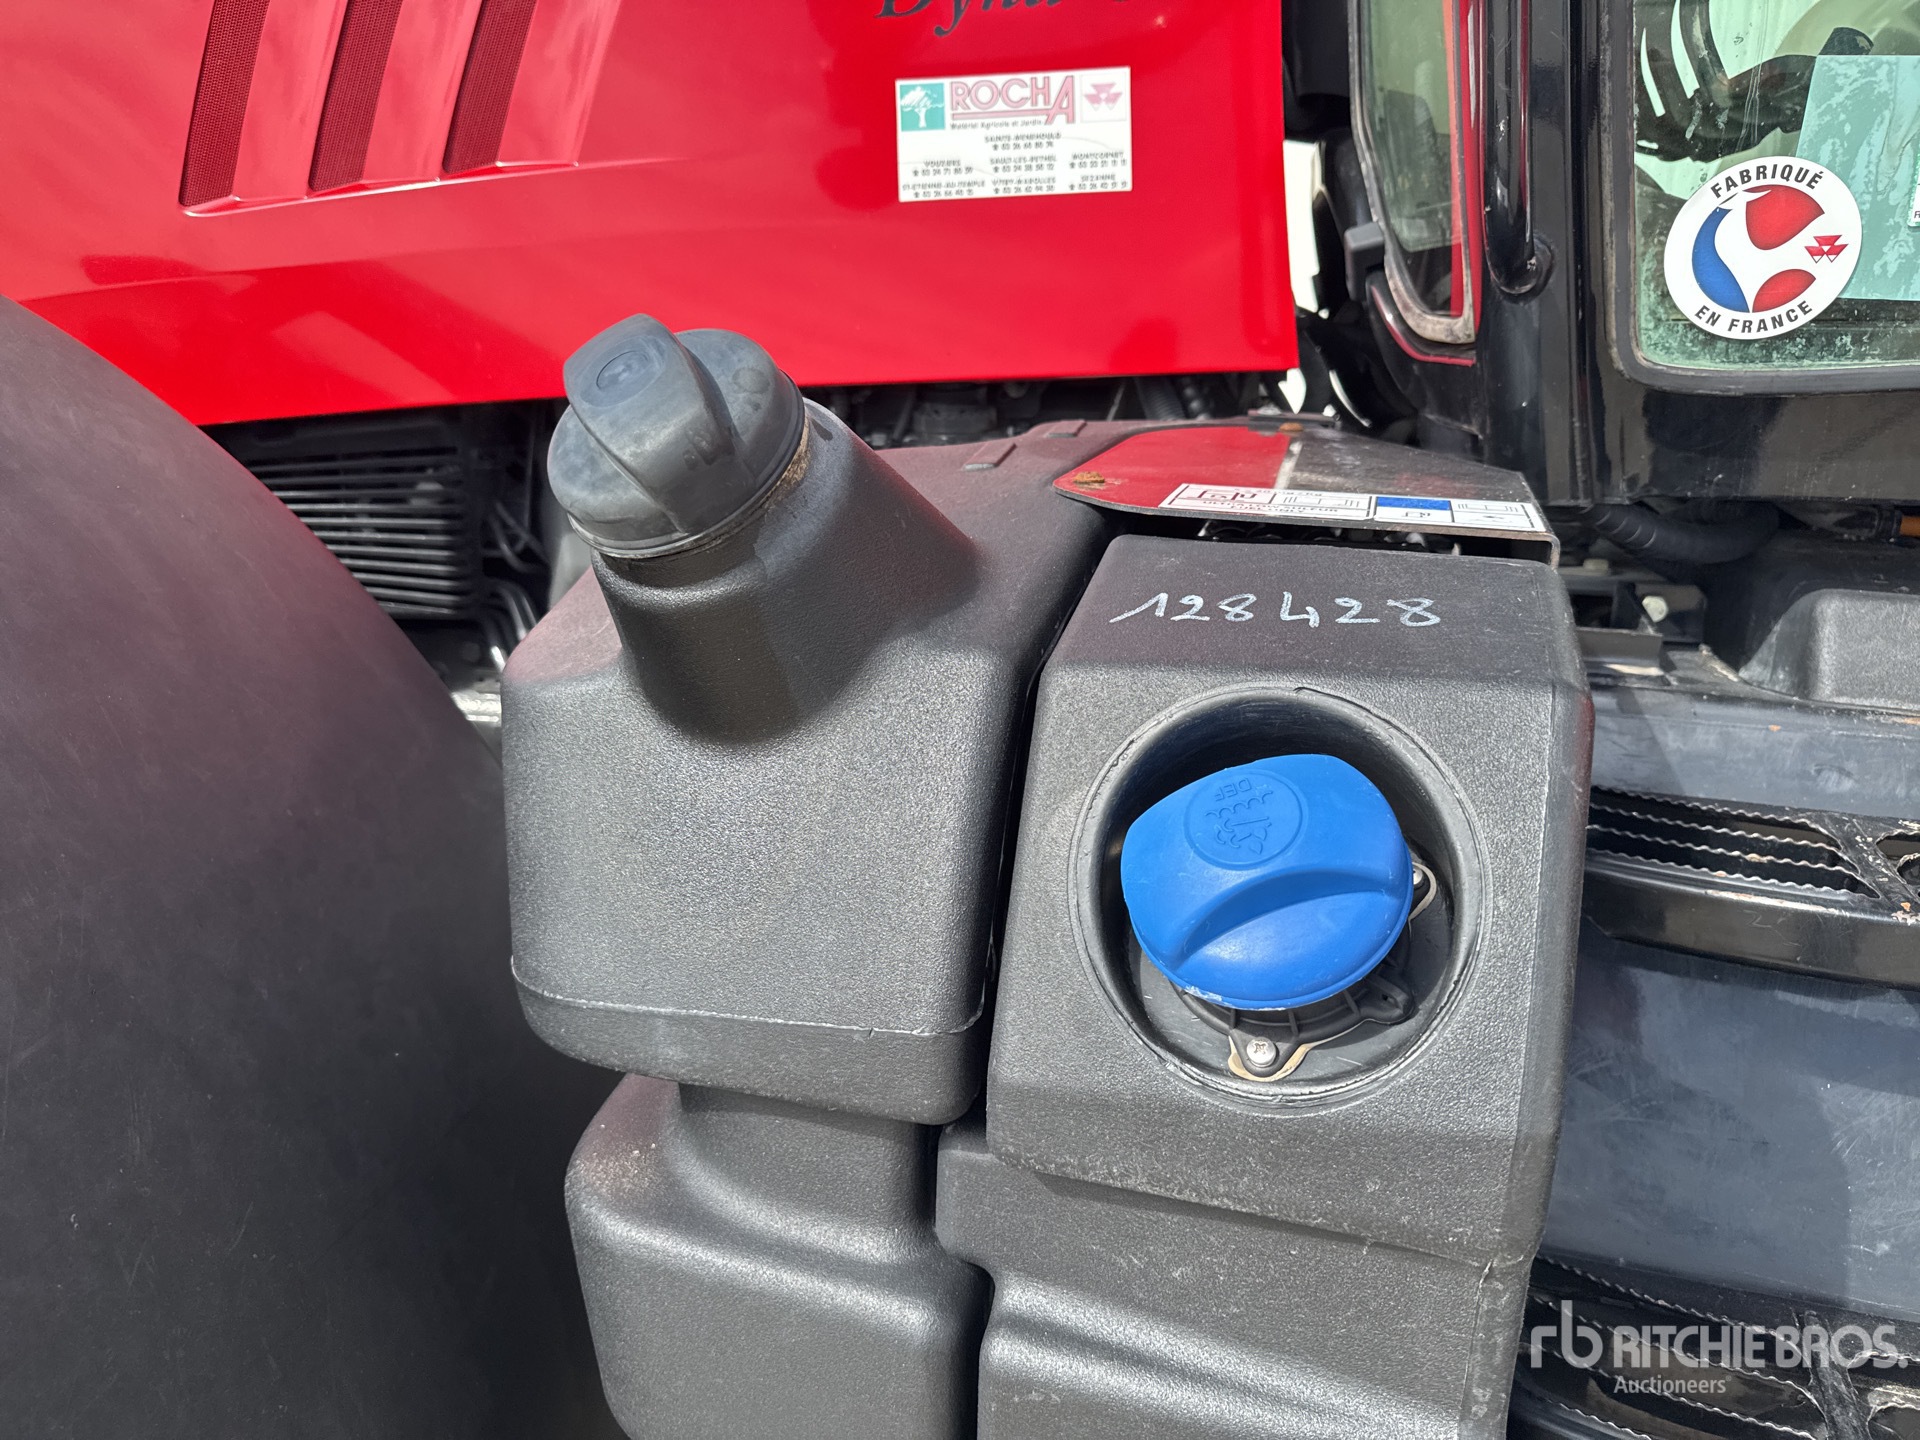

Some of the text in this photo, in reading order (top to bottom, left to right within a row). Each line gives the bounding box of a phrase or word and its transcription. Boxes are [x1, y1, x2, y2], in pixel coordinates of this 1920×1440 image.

[950, 75, 1075, 125] ROCHA
[1711, 164, 1824, 198] FABRIQUÉ
[1694, 301, 1813, 333] EN FRANCE
